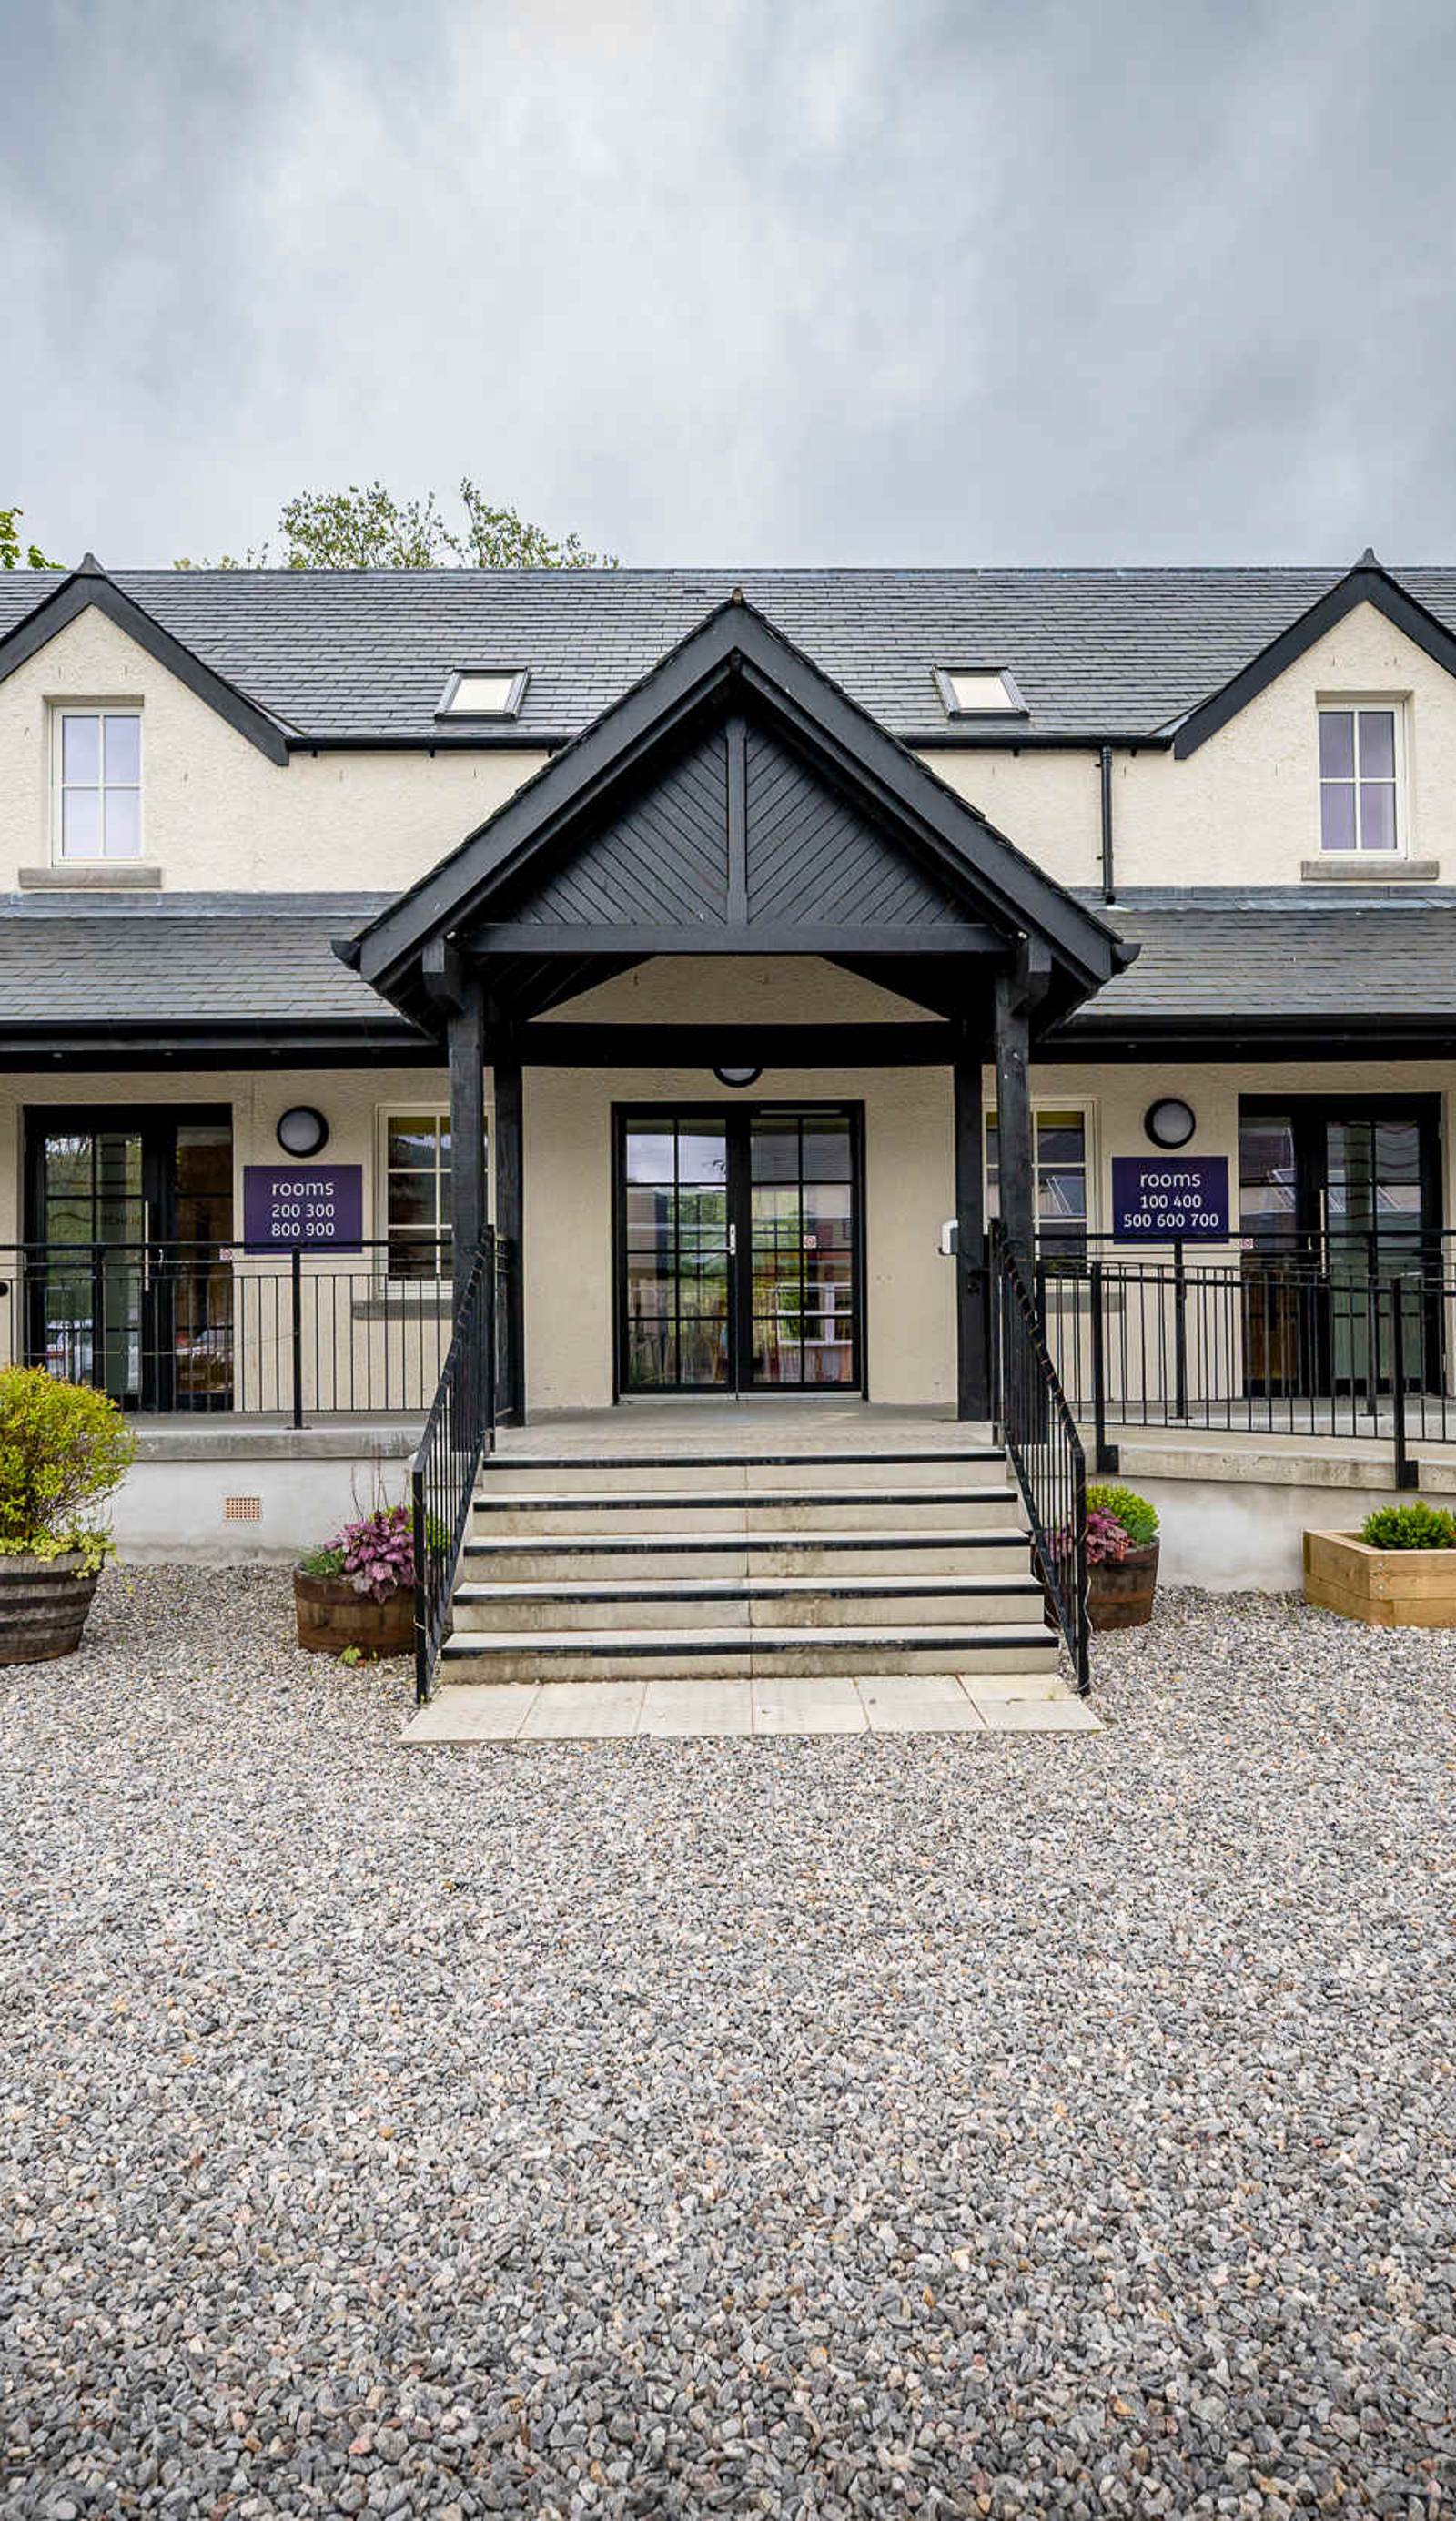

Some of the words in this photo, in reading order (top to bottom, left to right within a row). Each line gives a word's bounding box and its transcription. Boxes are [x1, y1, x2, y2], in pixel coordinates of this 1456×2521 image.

[1140, 1173, 1201, 1187] rooms
[272, 1182, 335, 1196] rooms
[1140, 1195, 1168, 1209] 100
[1173, 1195, 1202, 1209] 400
[272, 1204, 301, 1218] 200
[306, 1204, 335, 1217] 300
[1123, 1214, 1152, 1228] 500
[1157, 1214, 1186, 1227] 600
[1191, 1213, 1219, 1227] 700
[272, 1223, 301, 1237] 800
[306, 1223, 335, 1237] 900
